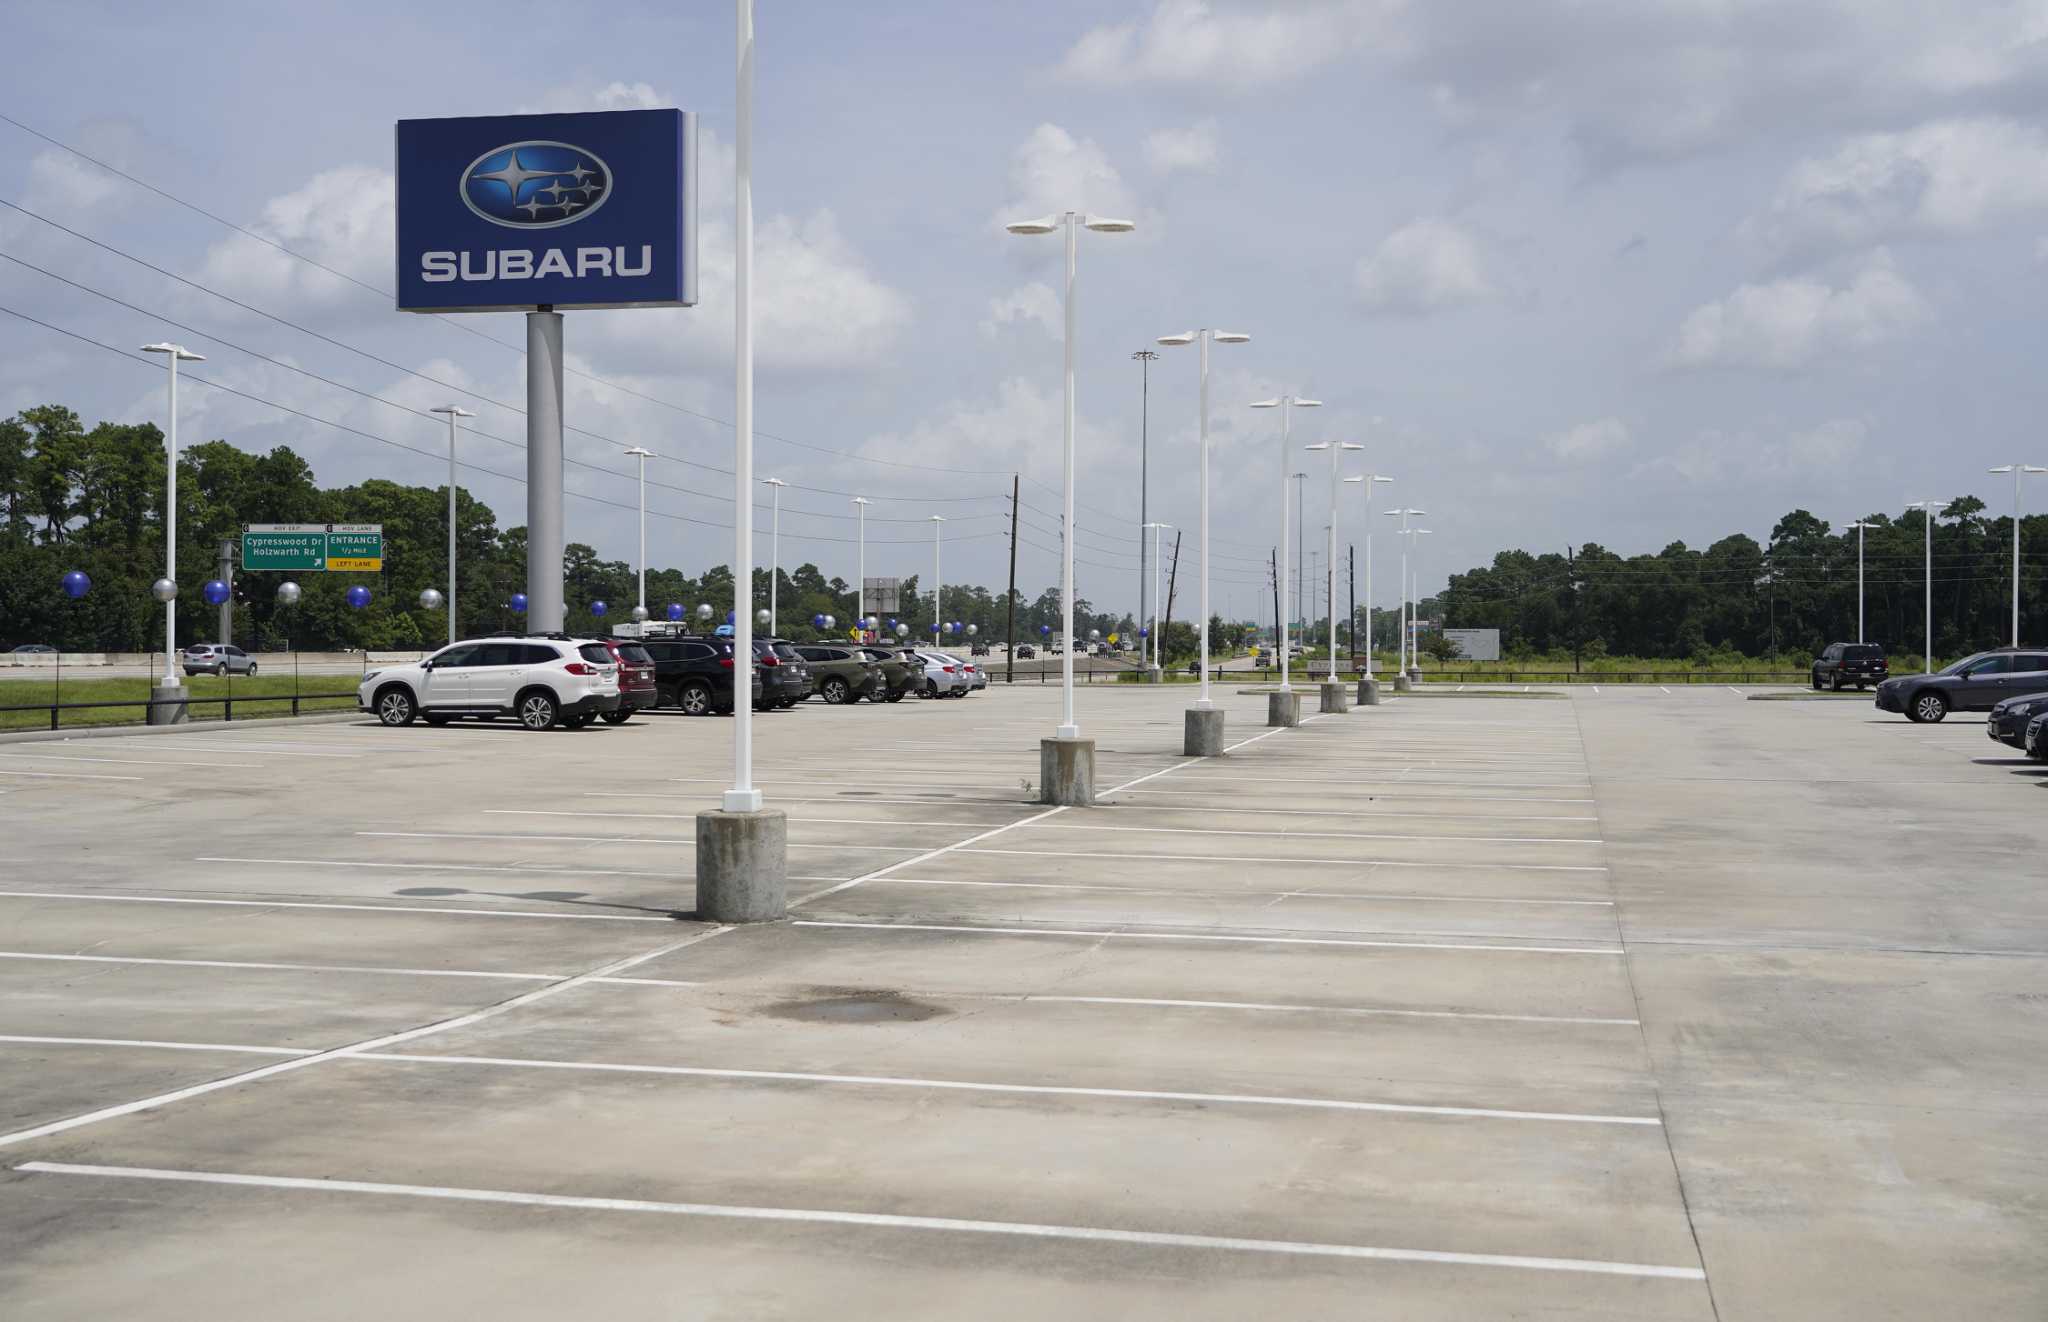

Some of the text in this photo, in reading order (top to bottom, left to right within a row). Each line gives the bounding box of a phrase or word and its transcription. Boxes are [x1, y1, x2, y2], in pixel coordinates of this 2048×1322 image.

[422, 245, 652, 282] SUBARU
[247, 538, 322, 547] Cypresswood Dr
[330, 536, 378, 544] ENTRANCE
[253, 548, 315, 556] Holzwarth Rd
